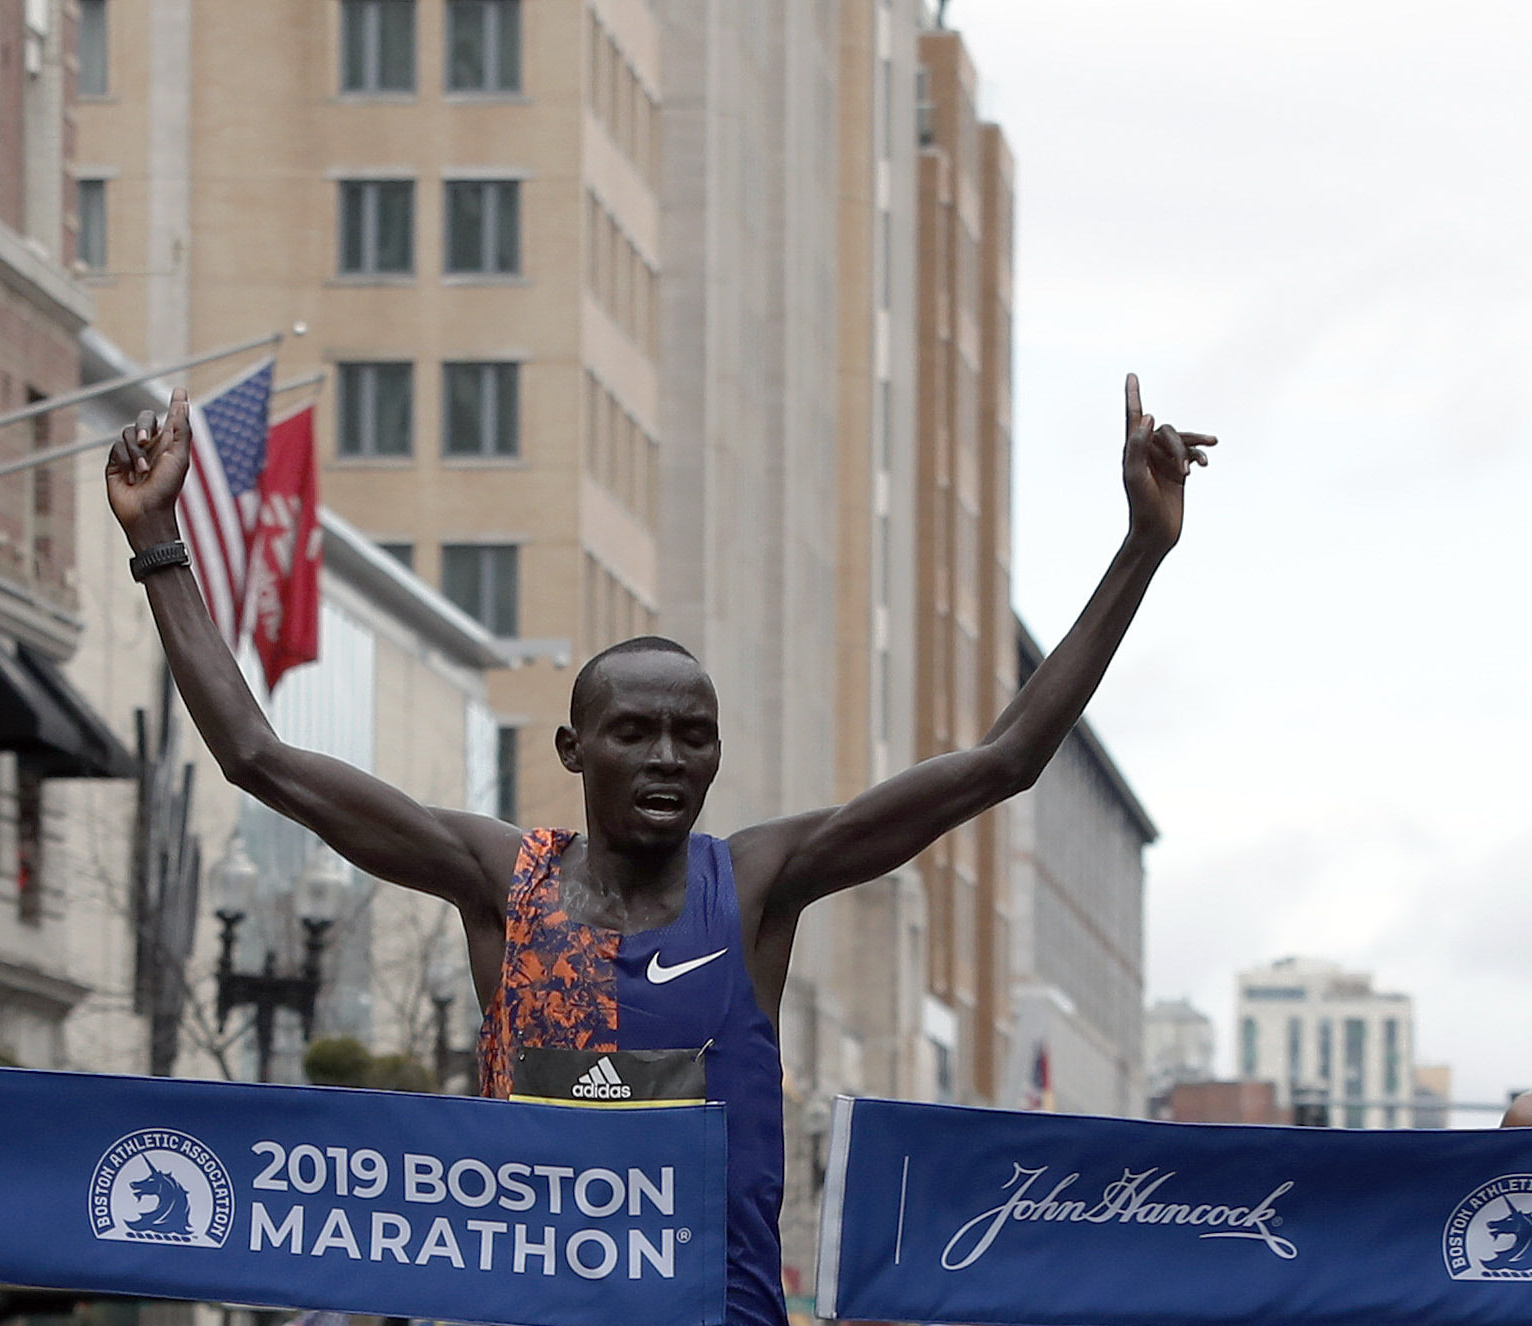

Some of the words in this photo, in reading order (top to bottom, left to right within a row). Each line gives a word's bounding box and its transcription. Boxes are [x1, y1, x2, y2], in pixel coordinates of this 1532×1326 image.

[571, 1082, 632, 1100] adidas
[94, 1165, 116, 1229] BOSTON
[109, 1133, 180, 1168] ATHLETIC
[179, 1139, 230, 1238] ASSOCIATION
[250, 1140, 389, 1198] 2019
[403, 1152, 674, 1218] BOSTON
[249, 1202, 675, 1279] MARATHON
[1448, 1208, 1474, 1270] BOSTON
